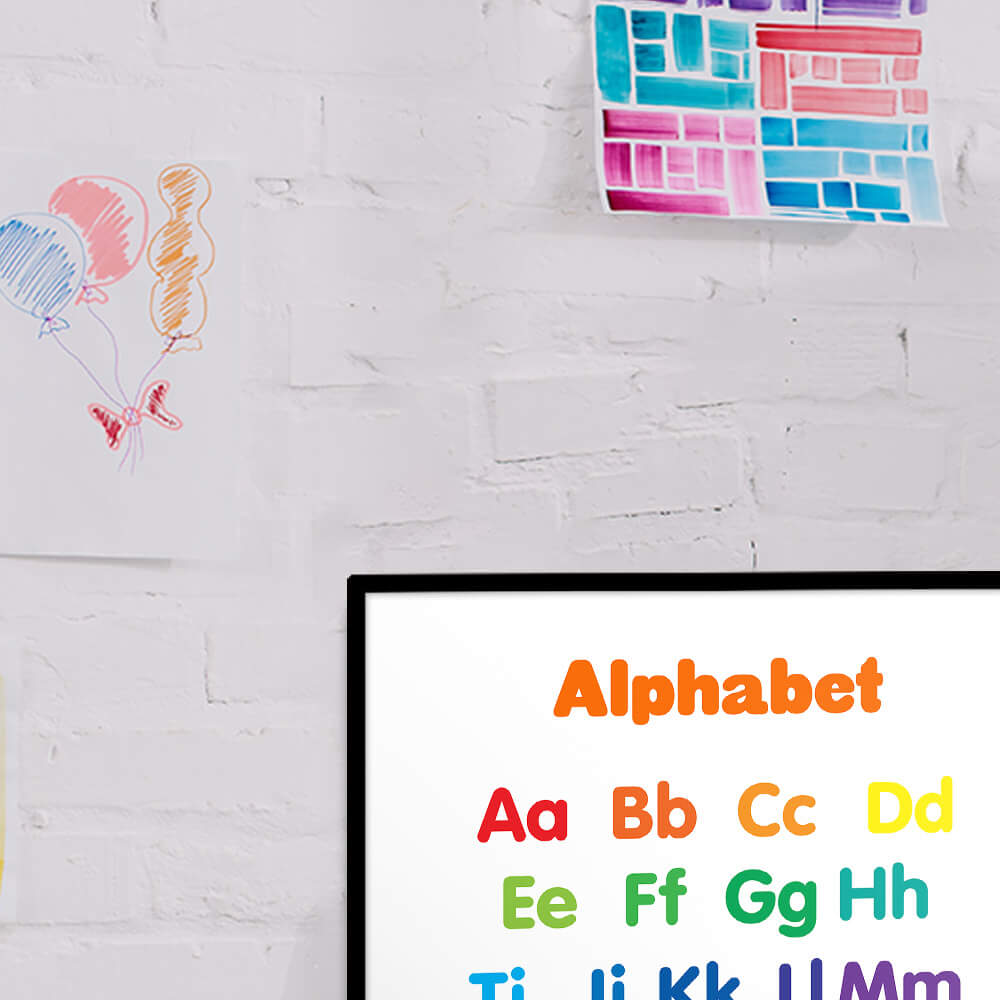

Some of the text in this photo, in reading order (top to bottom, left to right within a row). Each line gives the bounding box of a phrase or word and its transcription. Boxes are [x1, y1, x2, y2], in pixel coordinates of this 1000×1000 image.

[553, 657, 883, 725] Alphabet
[477, 776, 953, 843] Aa Bb Cc Dd
[503, 862, 928, 938] Ee Ff Gg Hh
